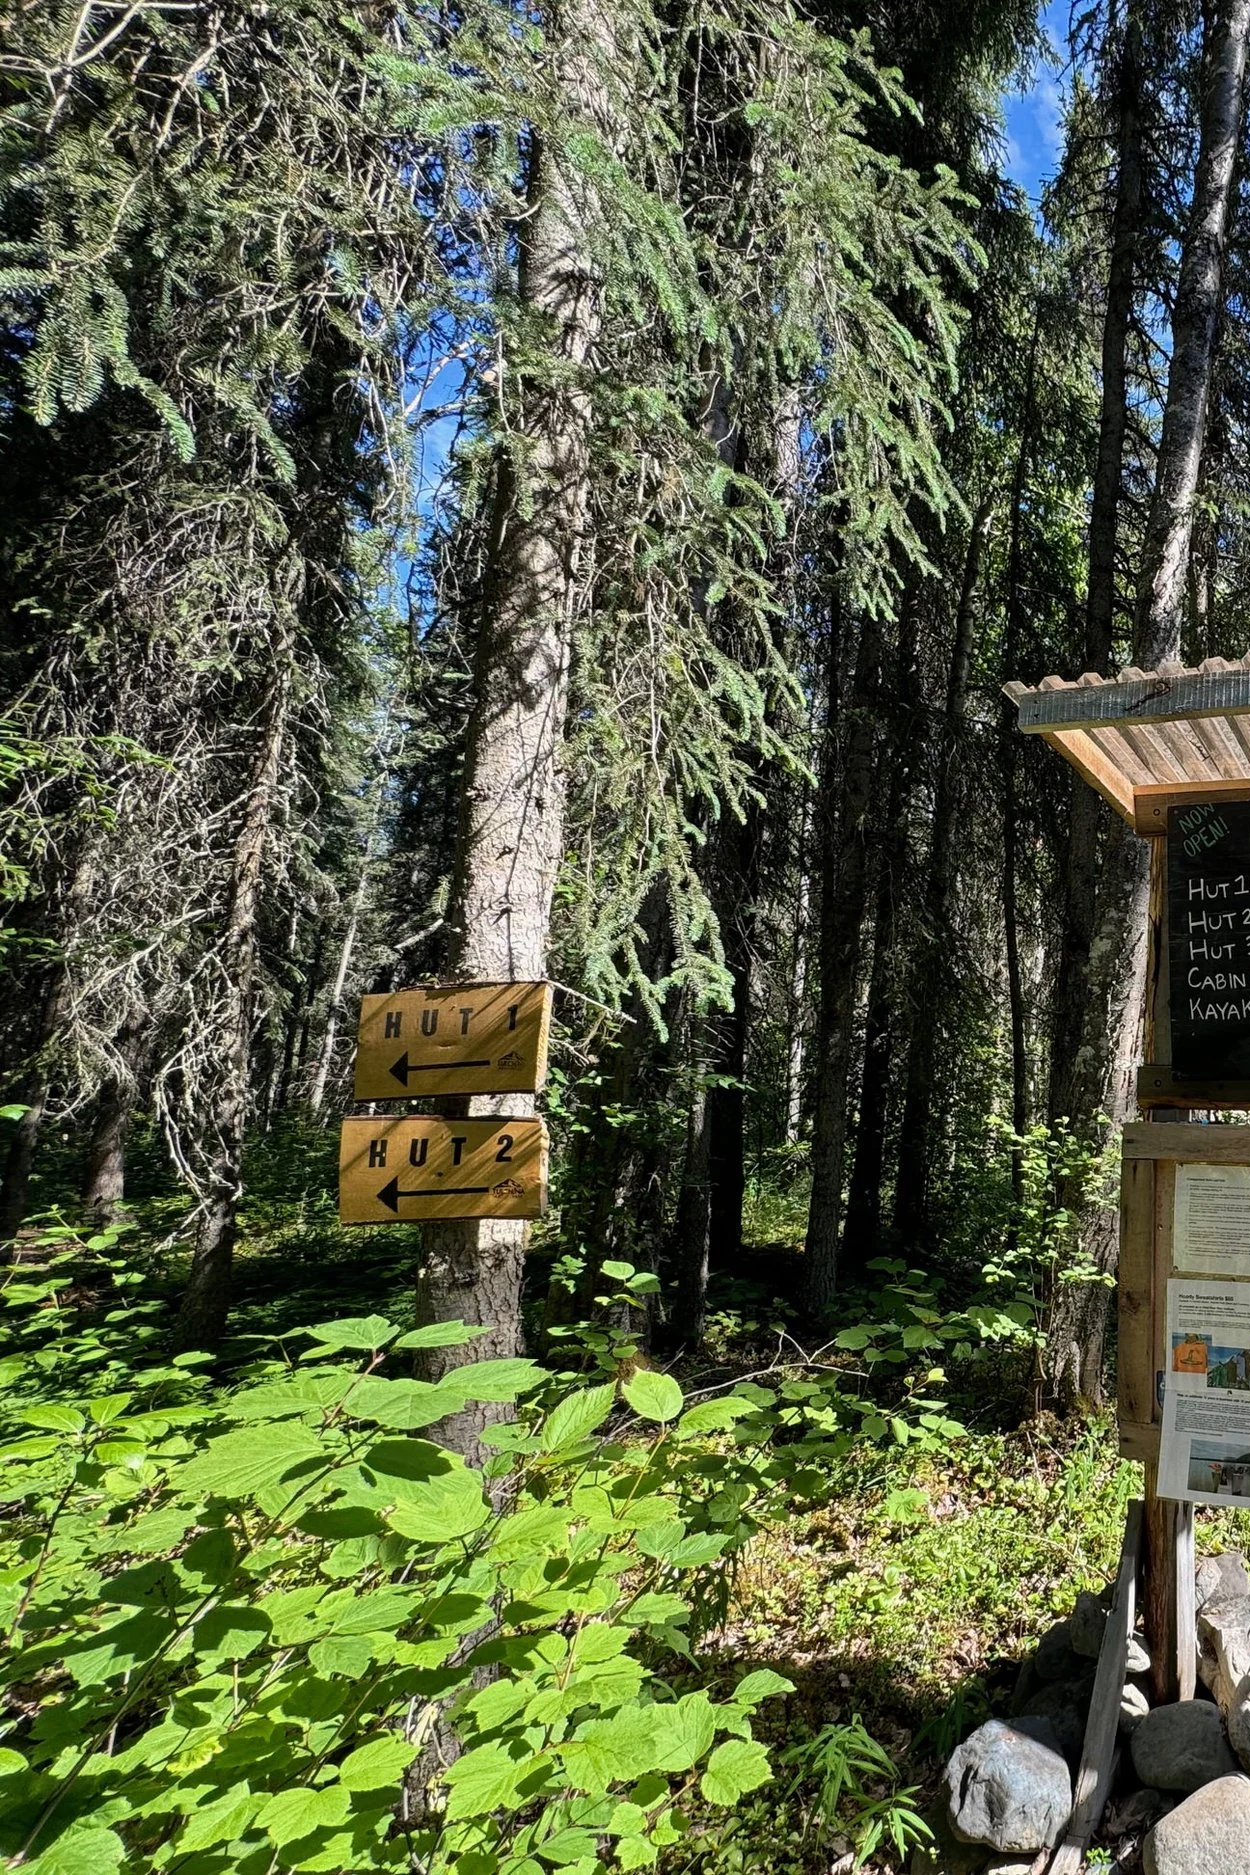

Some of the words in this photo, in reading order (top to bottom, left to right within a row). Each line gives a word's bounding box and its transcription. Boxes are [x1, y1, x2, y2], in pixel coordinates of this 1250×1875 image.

[1178, 803, 1215, 834] NOW
[1183, 816, 1230, 857] OPEN!
[1188, 878, 1230, 901] HUT
[1234, 875, 1249, 895] 1
[1188, 910, 1237, 933] HUT
[1189, 939, 1236, 960] HUT
[1187, 967, 1246, 991] CABIN
[384, 1007, 473, 1039] HUT
[507, 1004, 518, 1031] 1
[368, 1136, 467, 1168] HUT
[495, 1135, 513, 1162] 2
